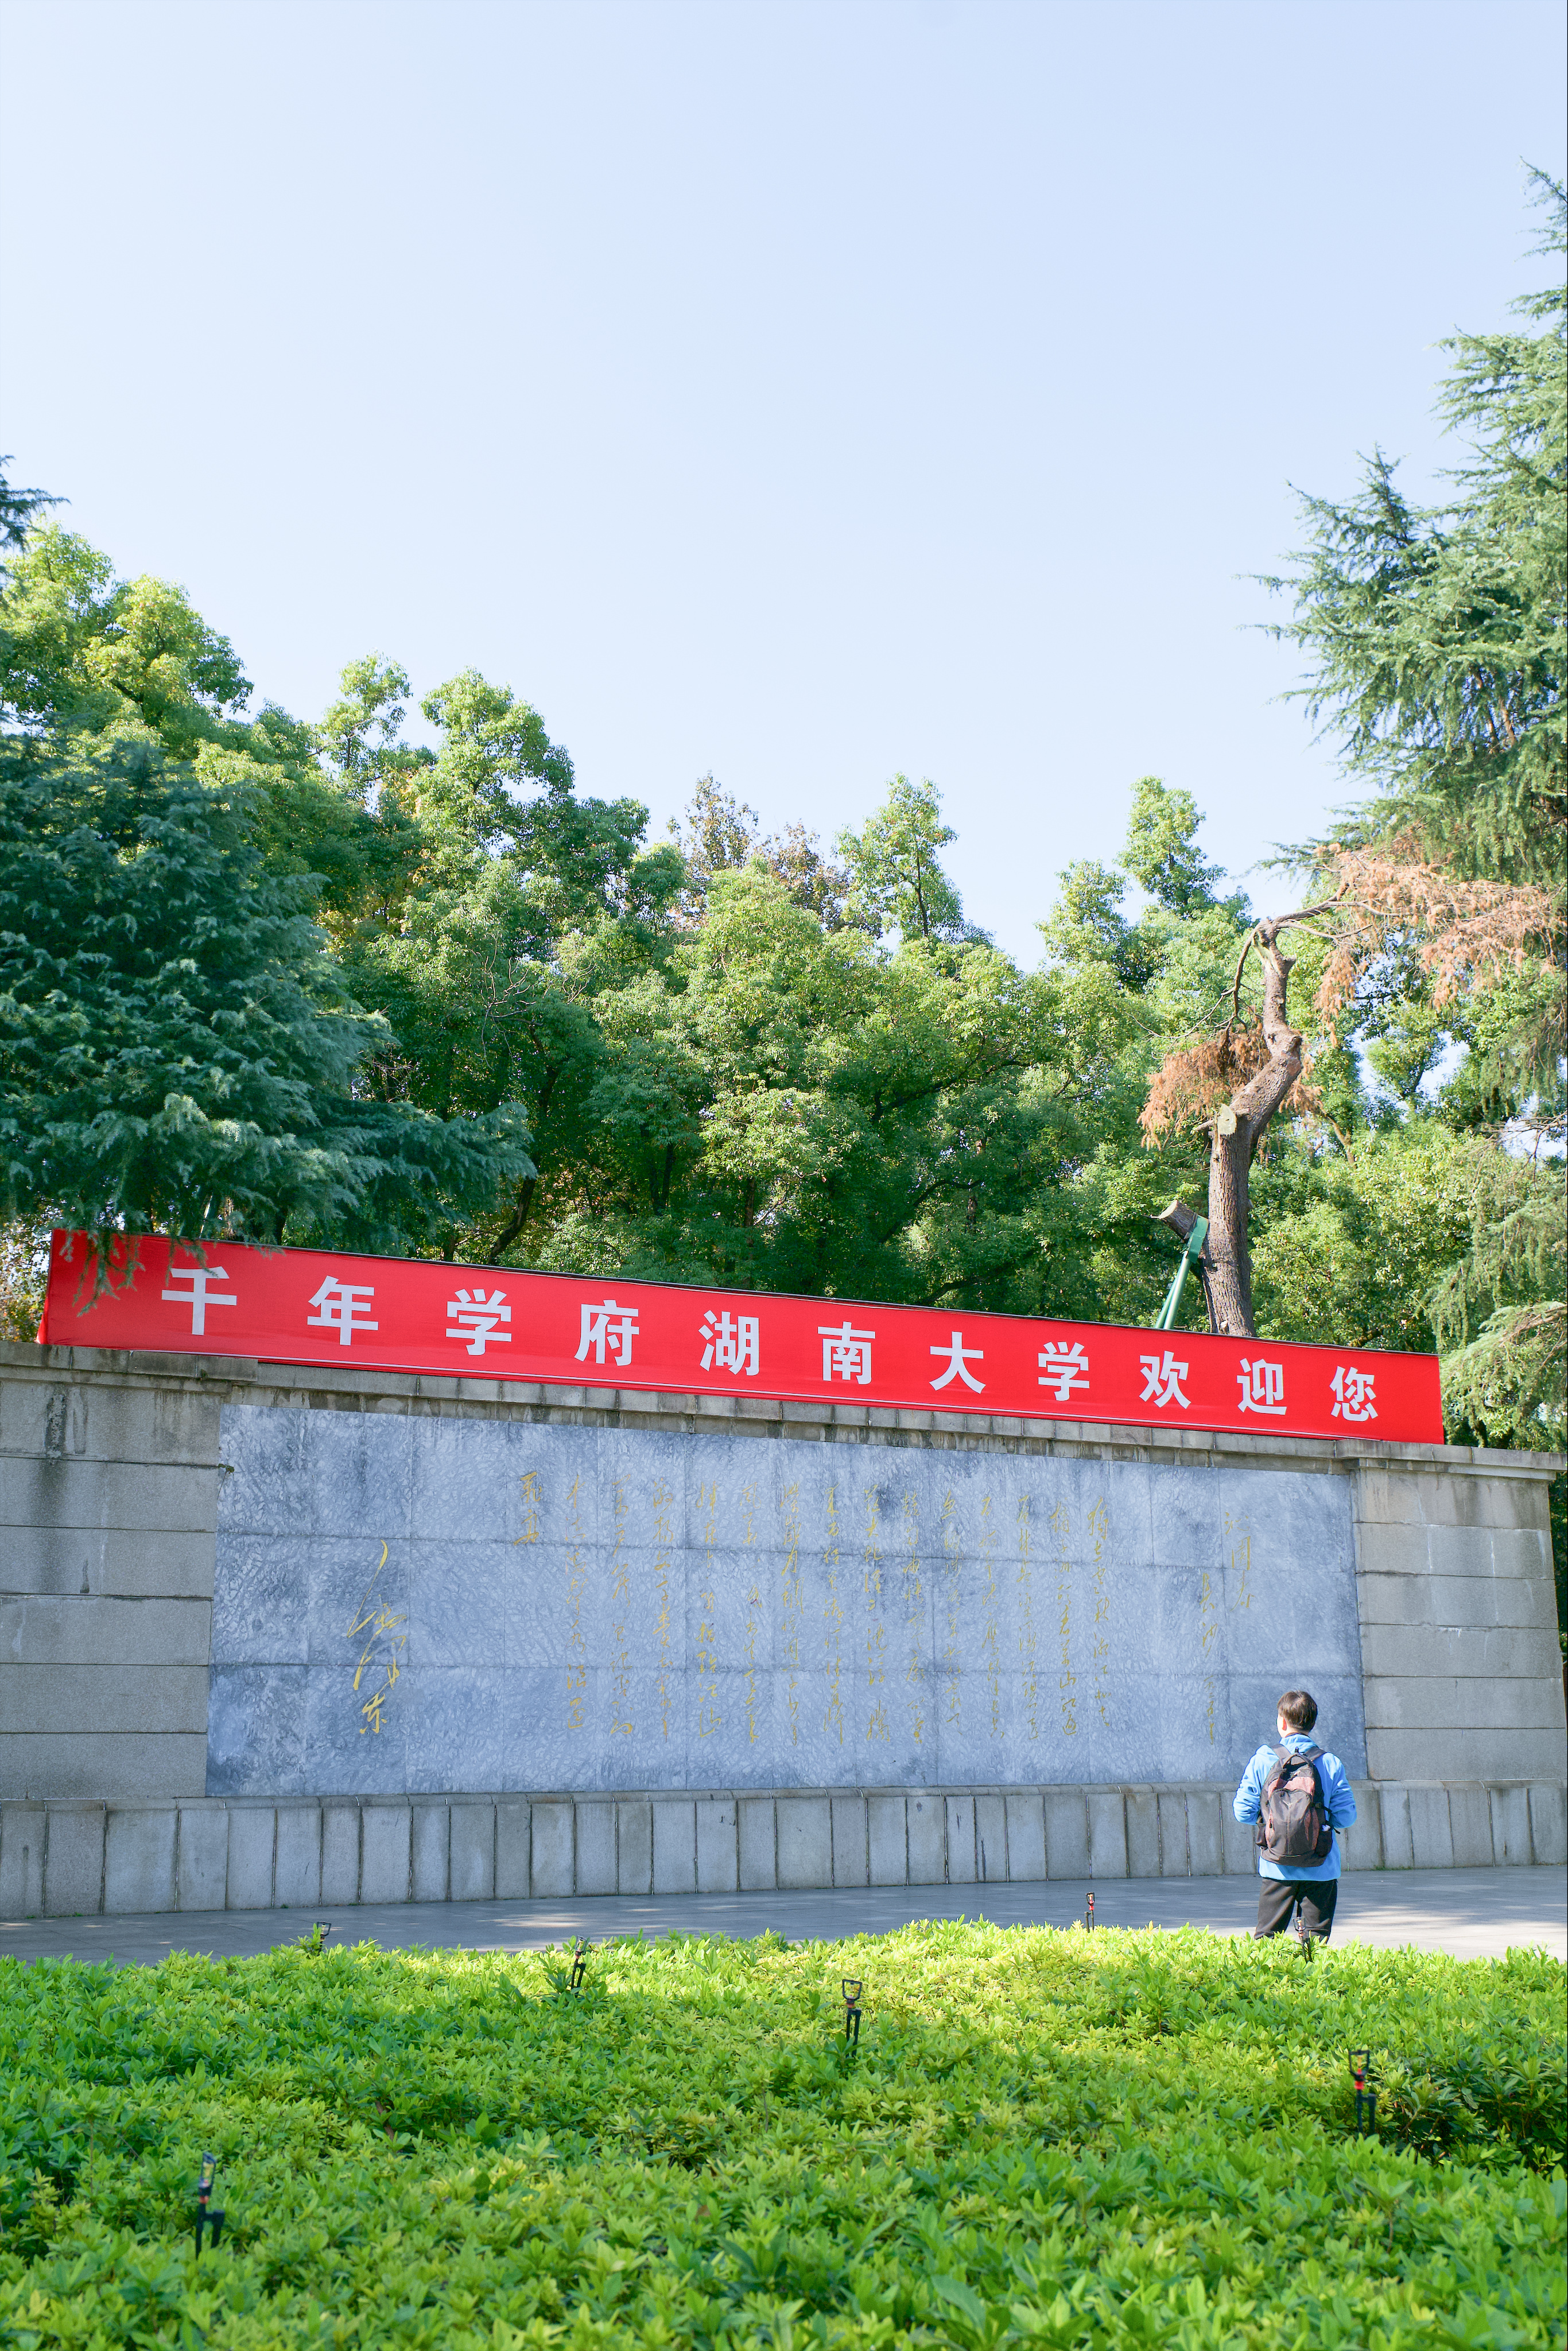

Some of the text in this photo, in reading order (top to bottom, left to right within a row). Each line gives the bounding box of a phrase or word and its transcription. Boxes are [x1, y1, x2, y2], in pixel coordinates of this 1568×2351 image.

[161, 1266, 1379, 1422] 千年学府湖南大学欢迎您
